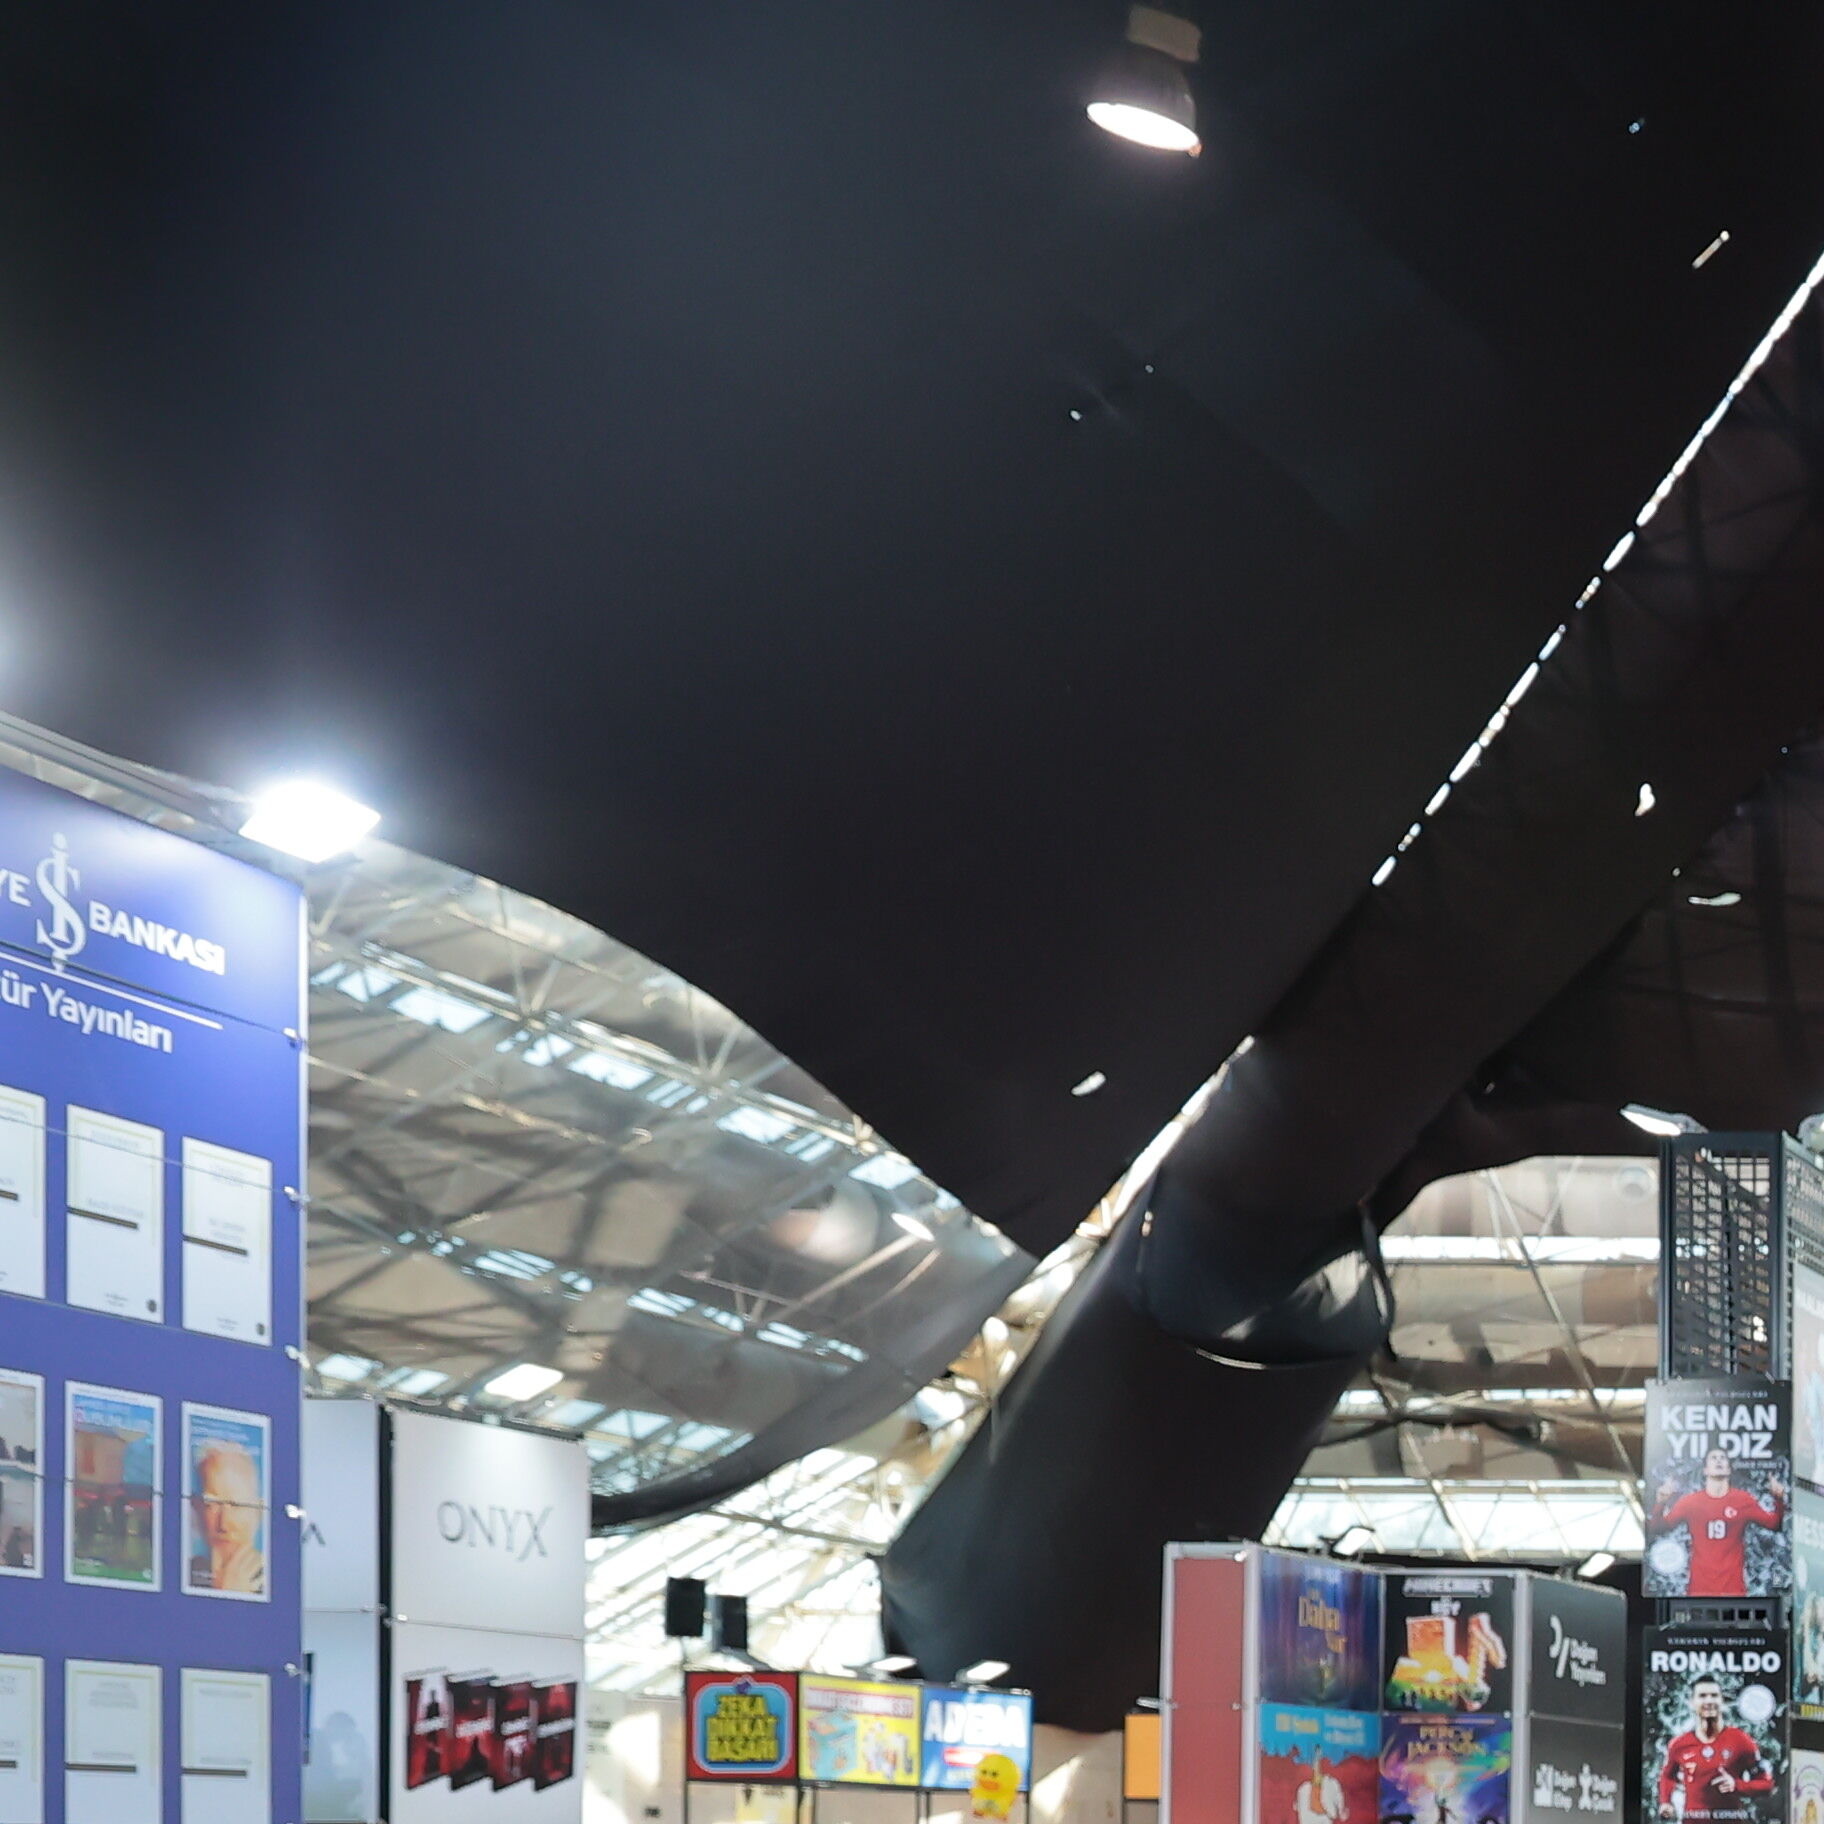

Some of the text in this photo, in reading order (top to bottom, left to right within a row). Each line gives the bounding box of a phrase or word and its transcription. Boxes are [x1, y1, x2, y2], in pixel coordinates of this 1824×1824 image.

[89, 900, 225, 976] BANKASI
[40, 982, 173, 1053] Yayınları
[1661, 1404, 1778, 1431] KENAN
[437, 1501, 554, 1562] ONYX
[1708, 1520, 1726, 1540] 19
[1651, 1651, 1781, 1673] RONALDO
